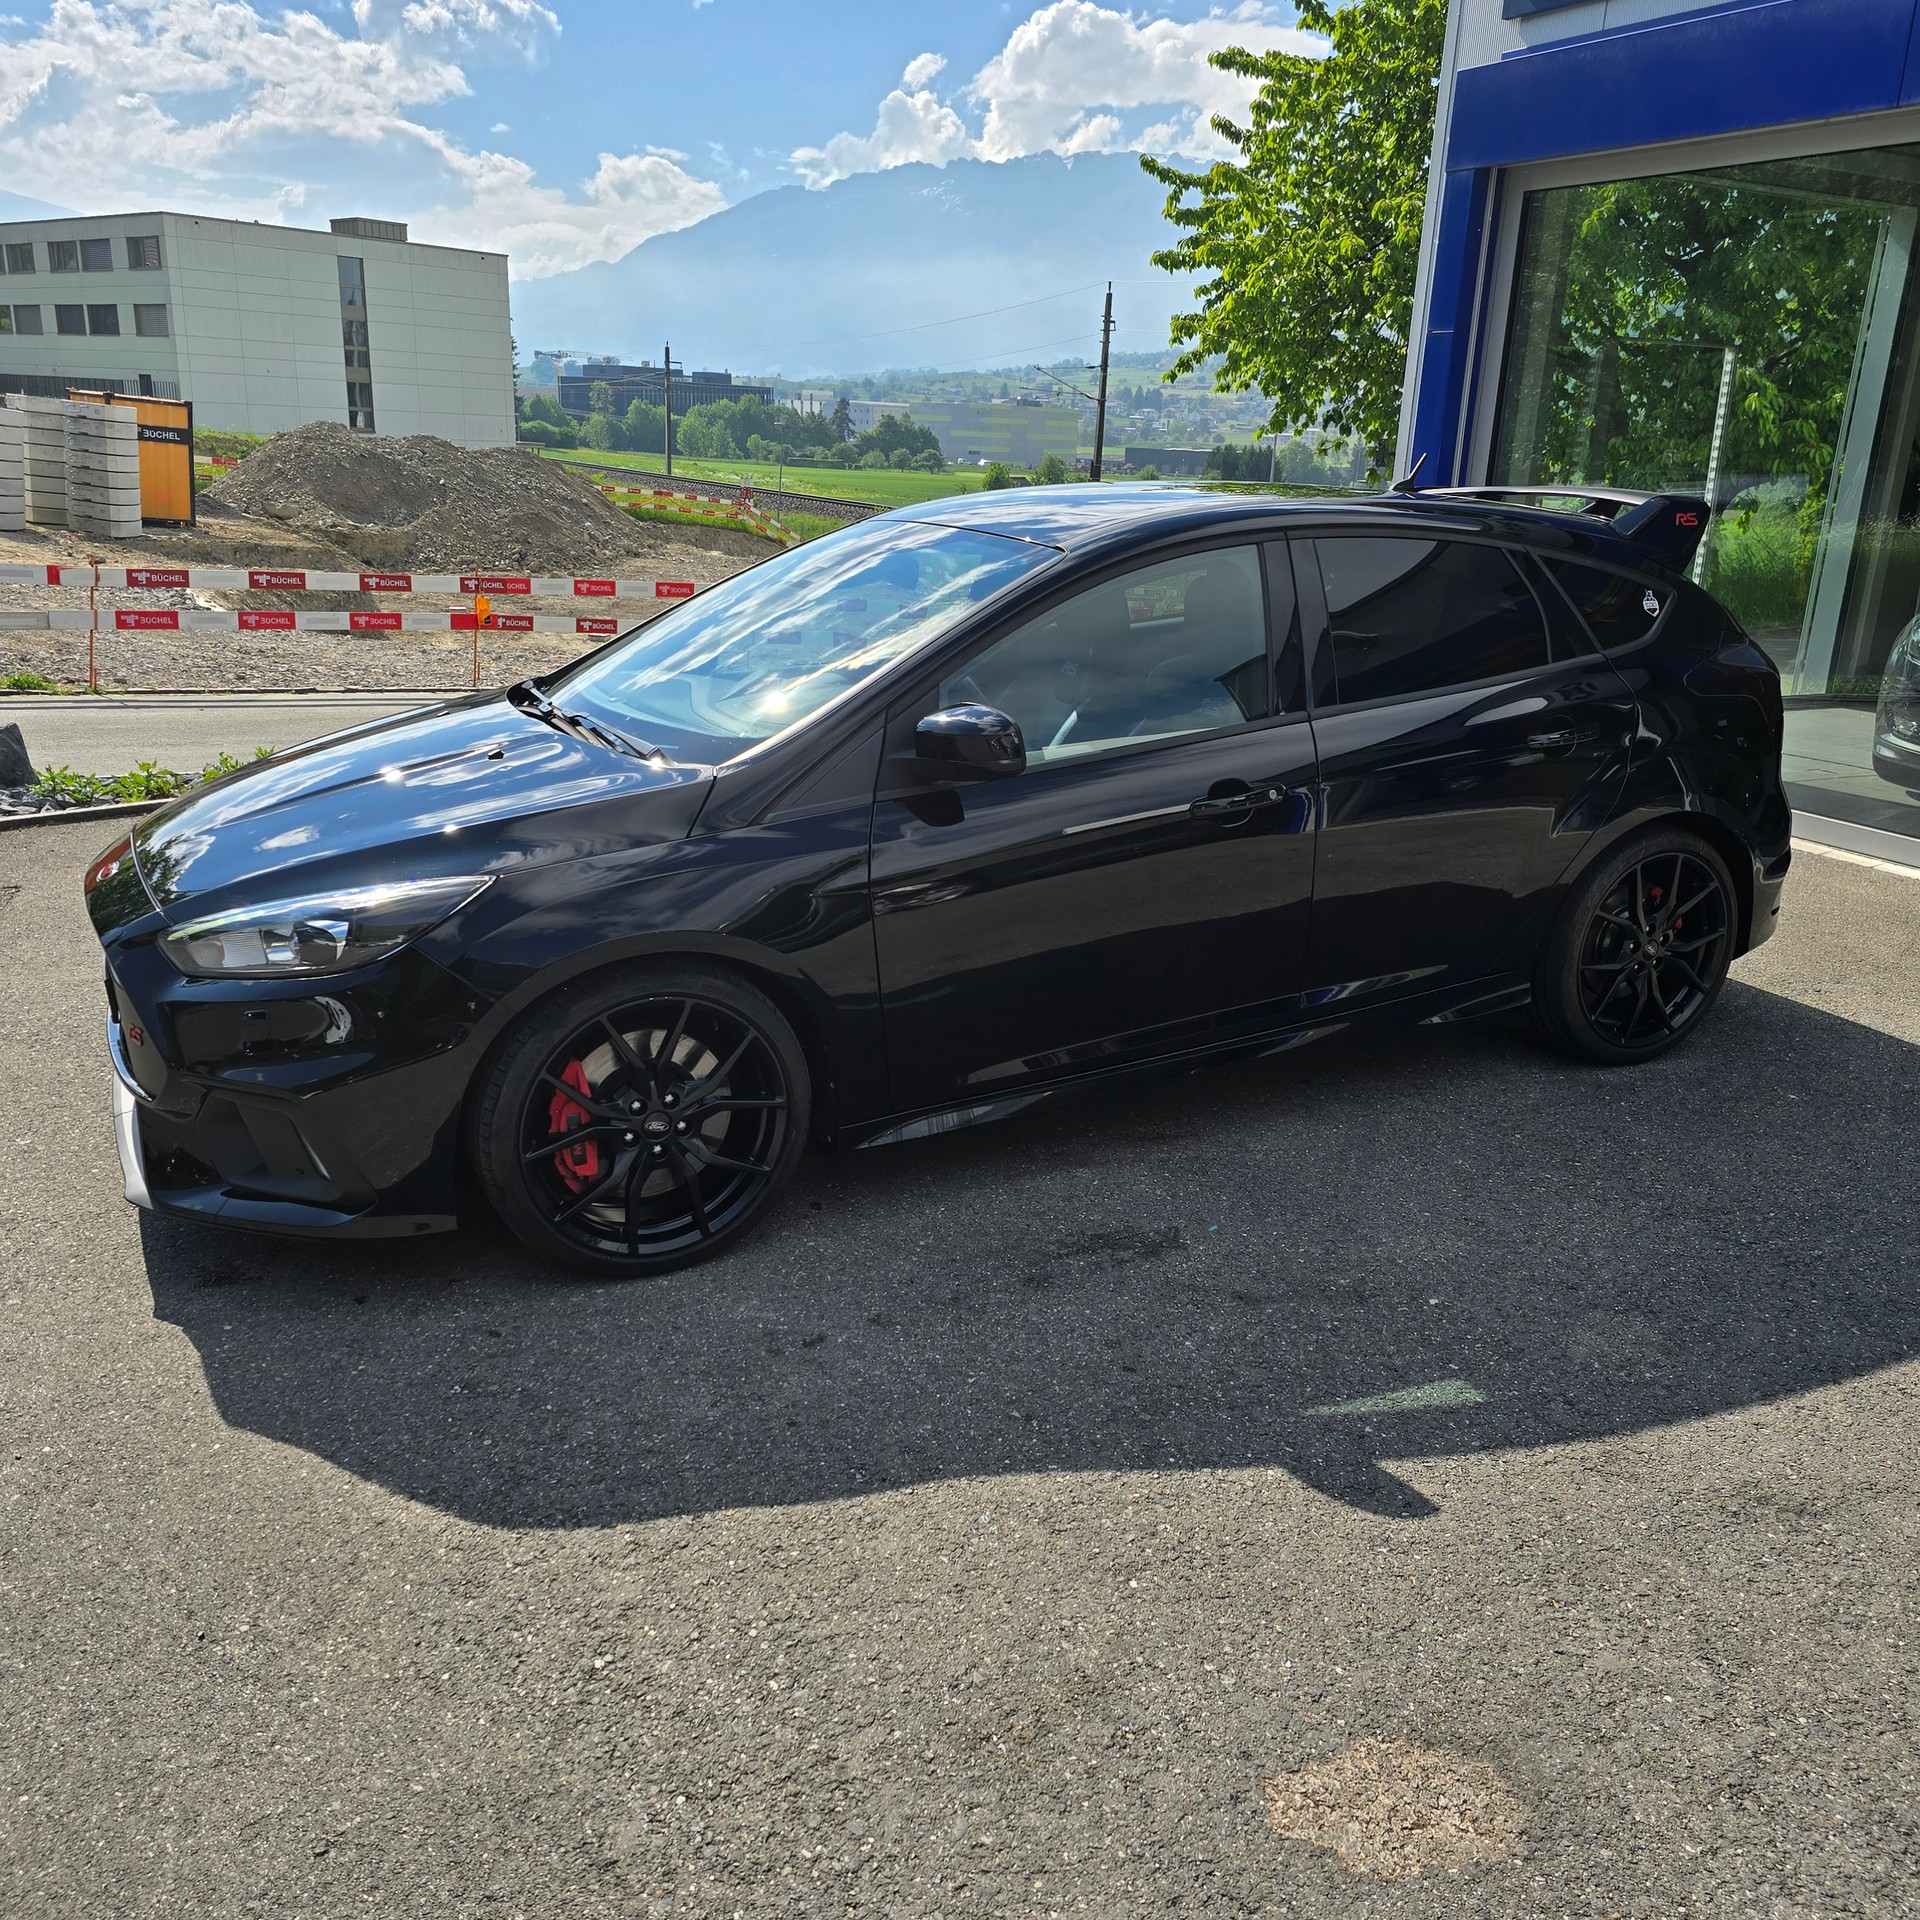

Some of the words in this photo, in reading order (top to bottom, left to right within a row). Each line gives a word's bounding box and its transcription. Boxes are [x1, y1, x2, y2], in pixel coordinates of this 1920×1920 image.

[1675, 512, 1699, 526] RS
[151, 573, 186, 583] BÜCHEL
[271, 576, 303, 585] BÜCHEL
[380, 578, 409, 587] BÜCHEL
[482, 580, 505, 589] ÜCHEL
[505, 619, 531, 627] BÜCHEL
[592, 622, 616, 631] BÜCHEL
